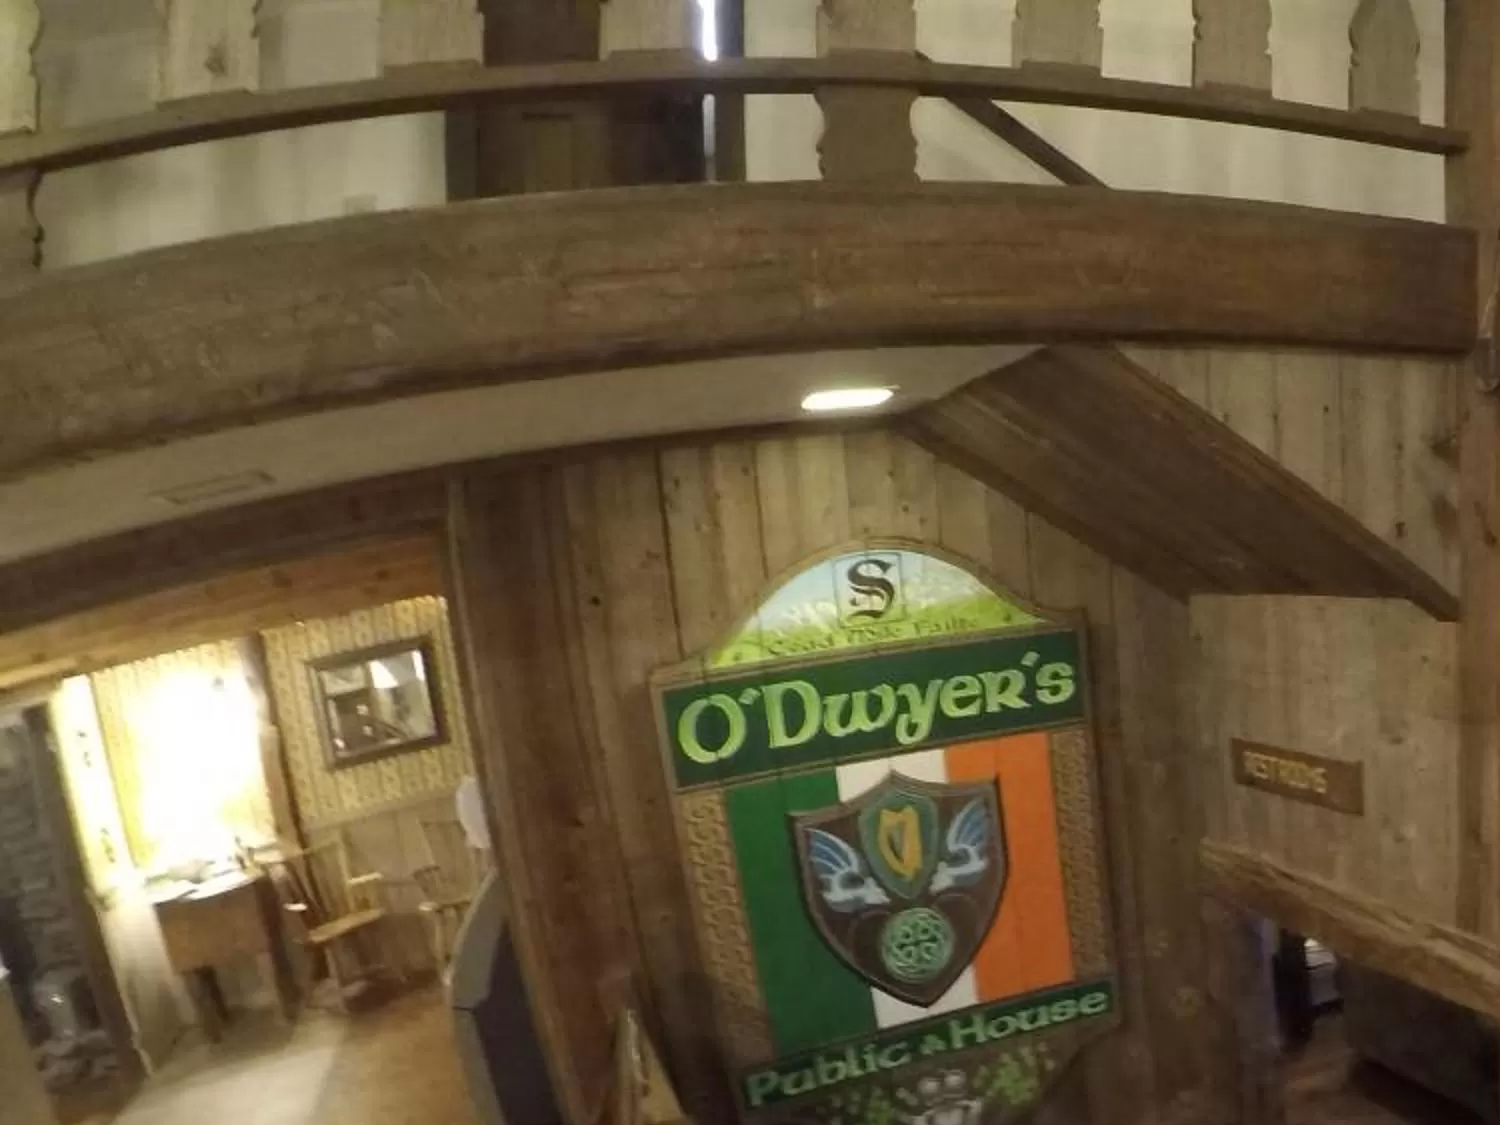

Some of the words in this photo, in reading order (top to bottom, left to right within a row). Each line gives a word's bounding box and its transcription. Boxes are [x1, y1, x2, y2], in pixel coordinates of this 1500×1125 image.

[846, 558, 895, 619] S
[747, 1038, 911, 1106] Public
[949, 991, 1107, 1050] House
